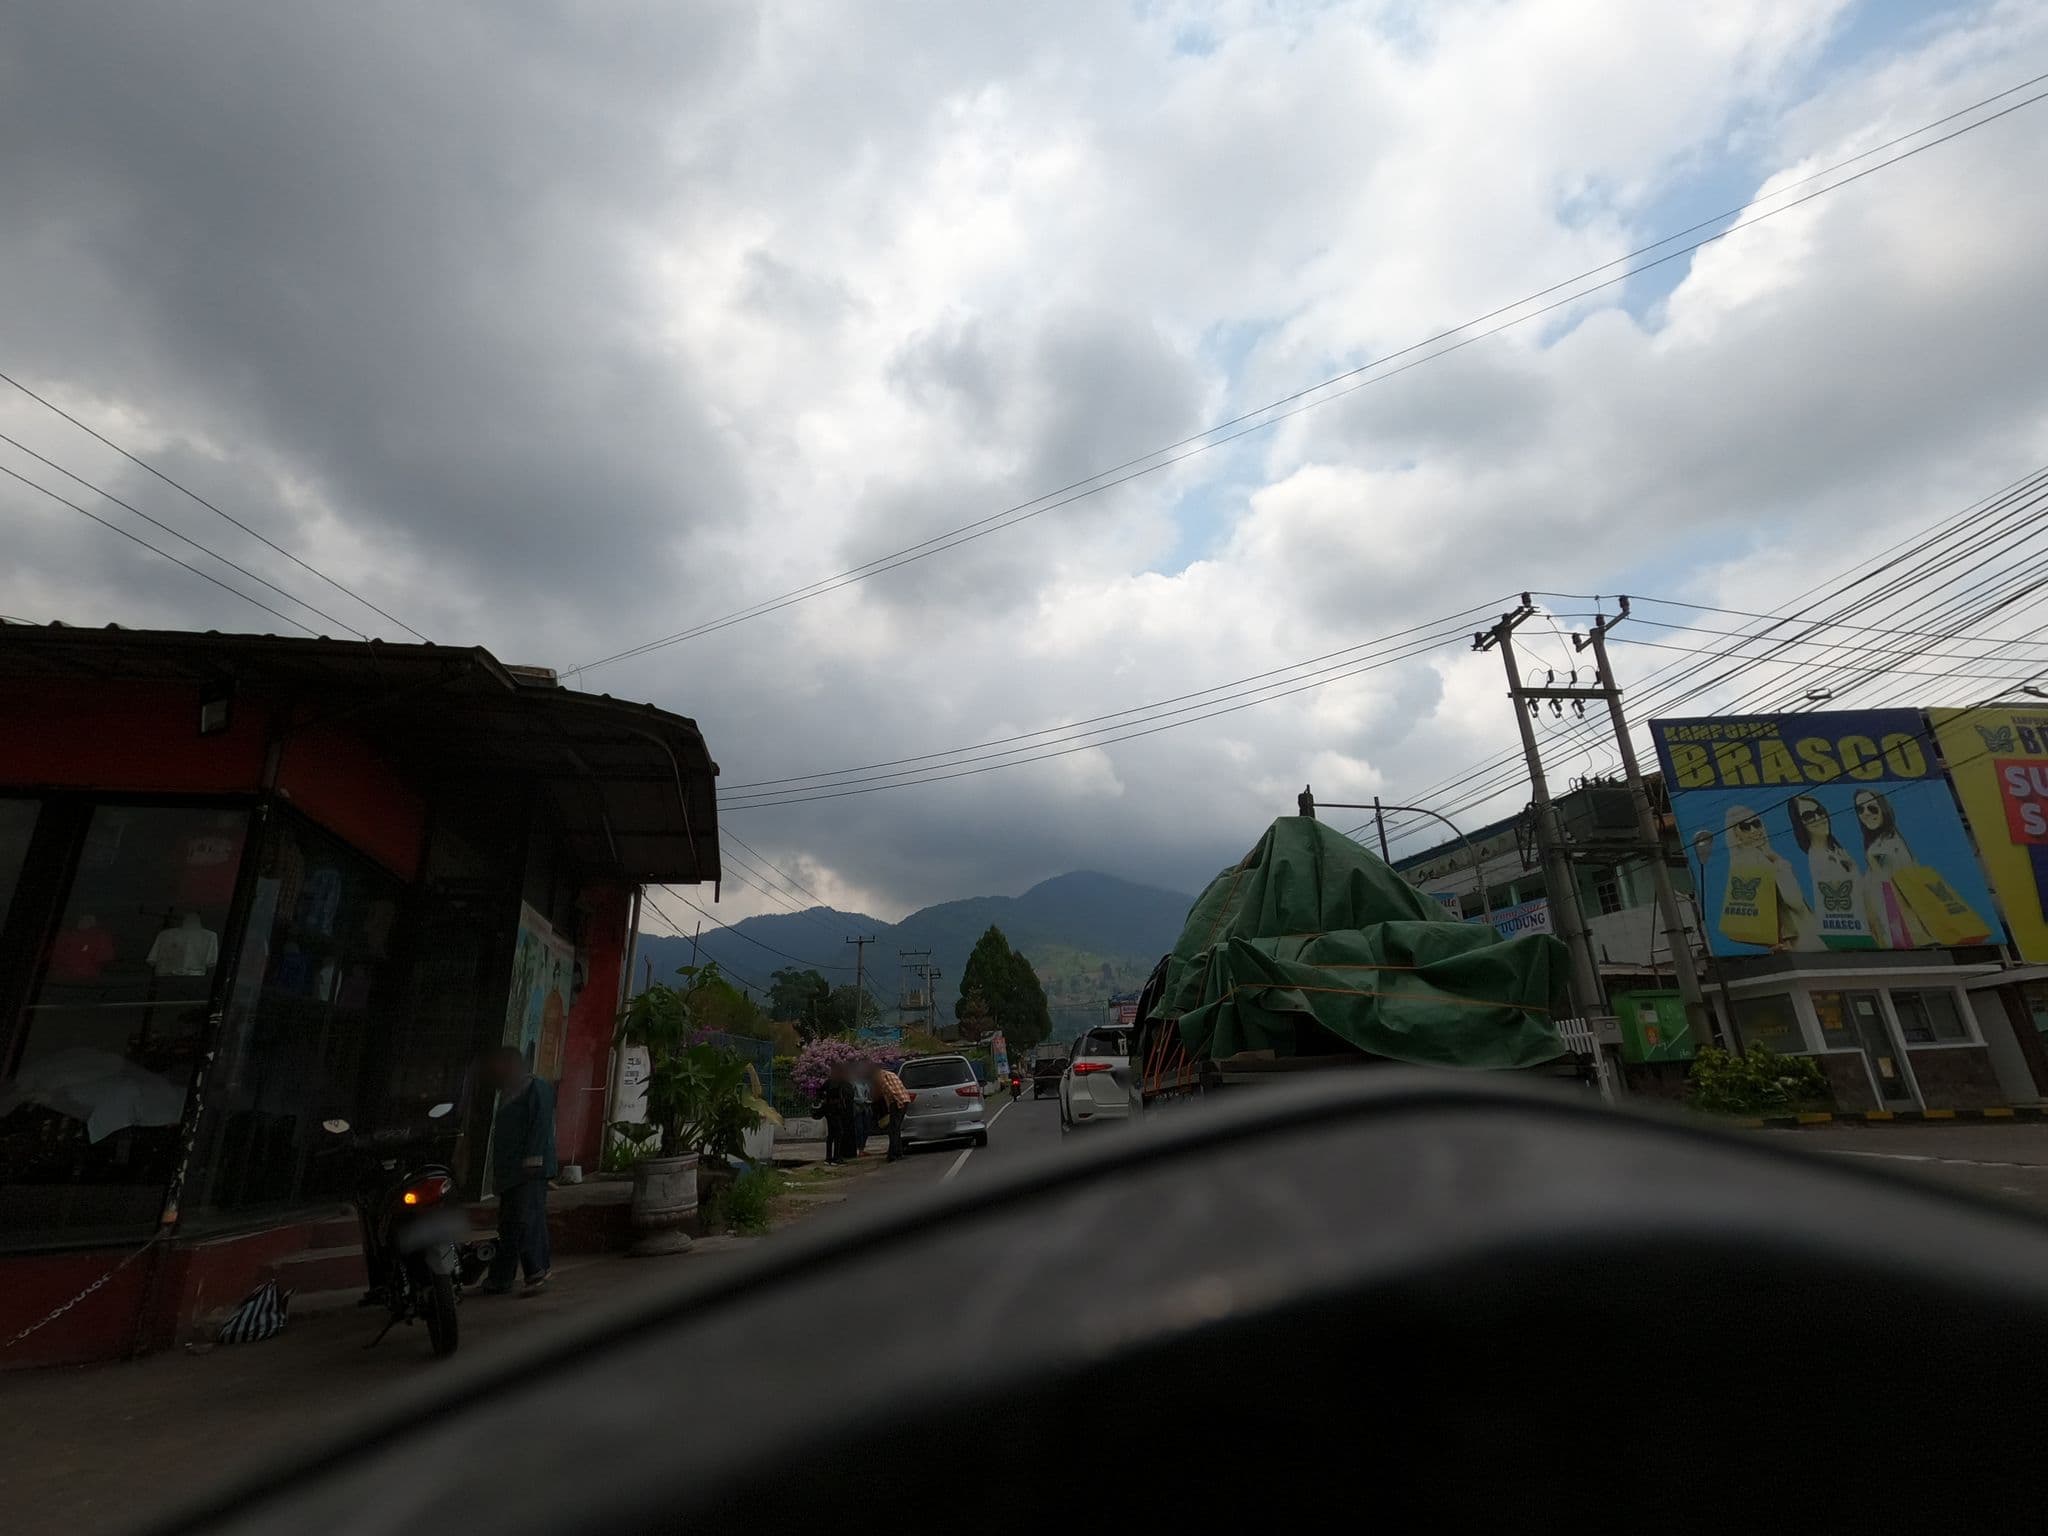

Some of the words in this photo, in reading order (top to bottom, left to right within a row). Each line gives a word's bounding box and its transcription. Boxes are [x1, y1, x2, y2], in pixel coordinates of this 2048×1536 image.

[1663, 722, 1780, 742] KAMPOENG
[1668, 733, 1928, 788] BRASCO
[1501, 912, 1546, 933] DUDUNG
[1823, 919, 1862, 930] BRASCO
